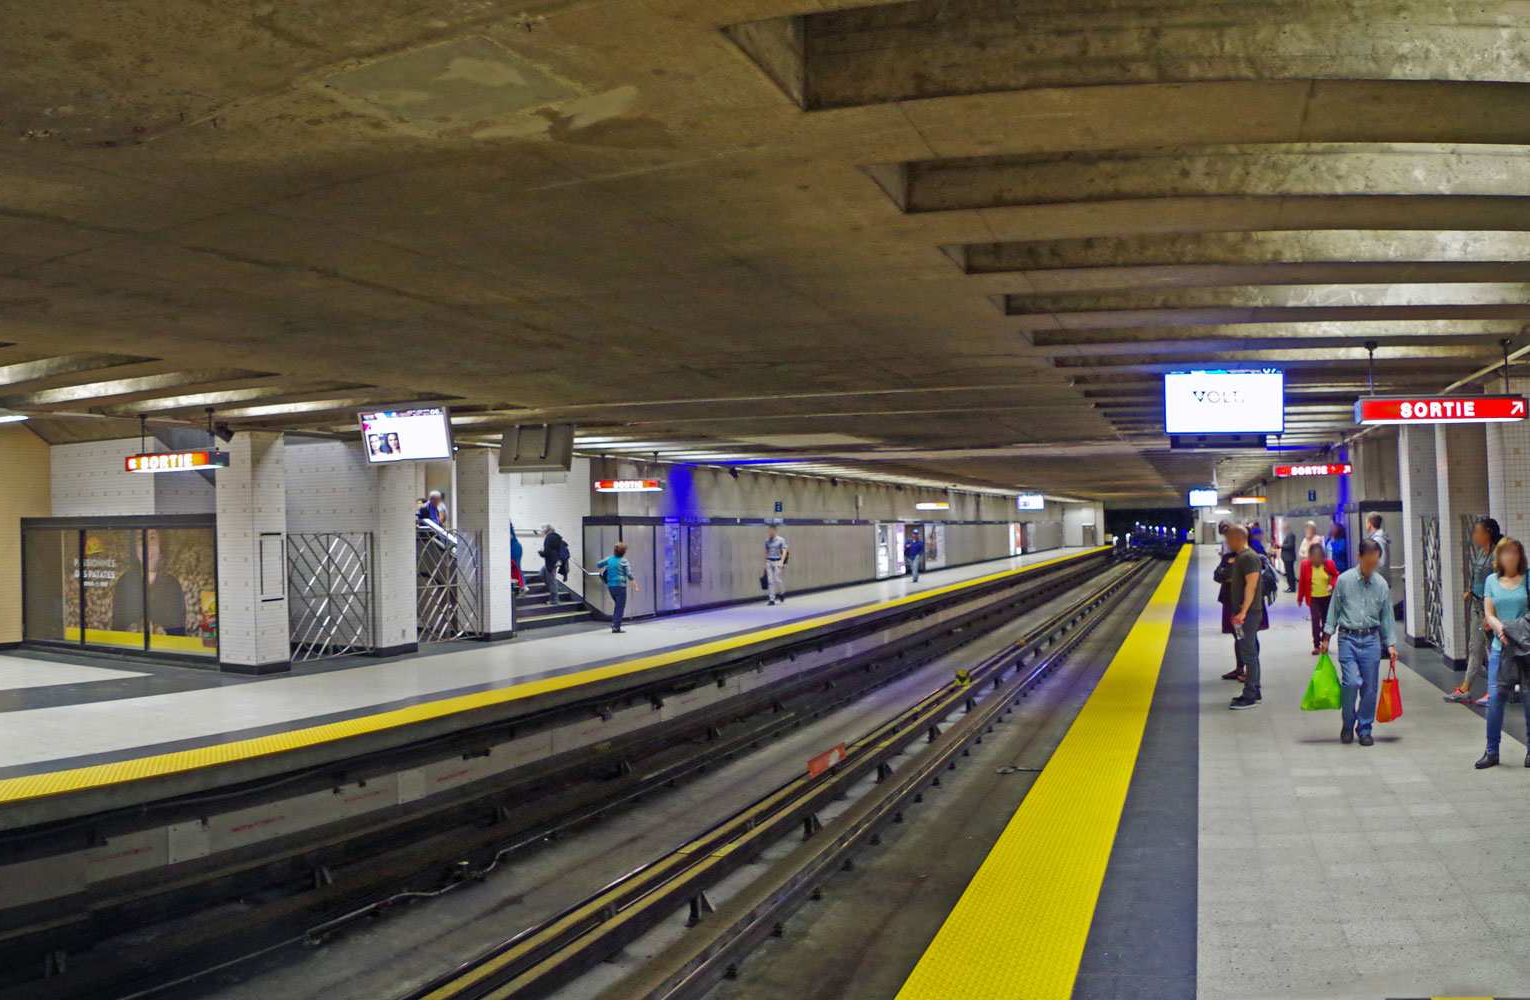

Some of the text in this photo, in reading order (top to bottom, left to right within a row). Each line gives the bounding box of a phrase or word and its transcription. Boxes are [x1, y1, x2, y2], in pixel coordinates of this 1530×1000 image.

[1400, 402, 1475, 418] SORTIE
[140, 453, 193, 470] SORTIE
[1290, 465, 1328, 476] SORTIE
[73, 557, 116, 568] PSSIONNÉS
[74, 569, 116, 579] DS PATATES
